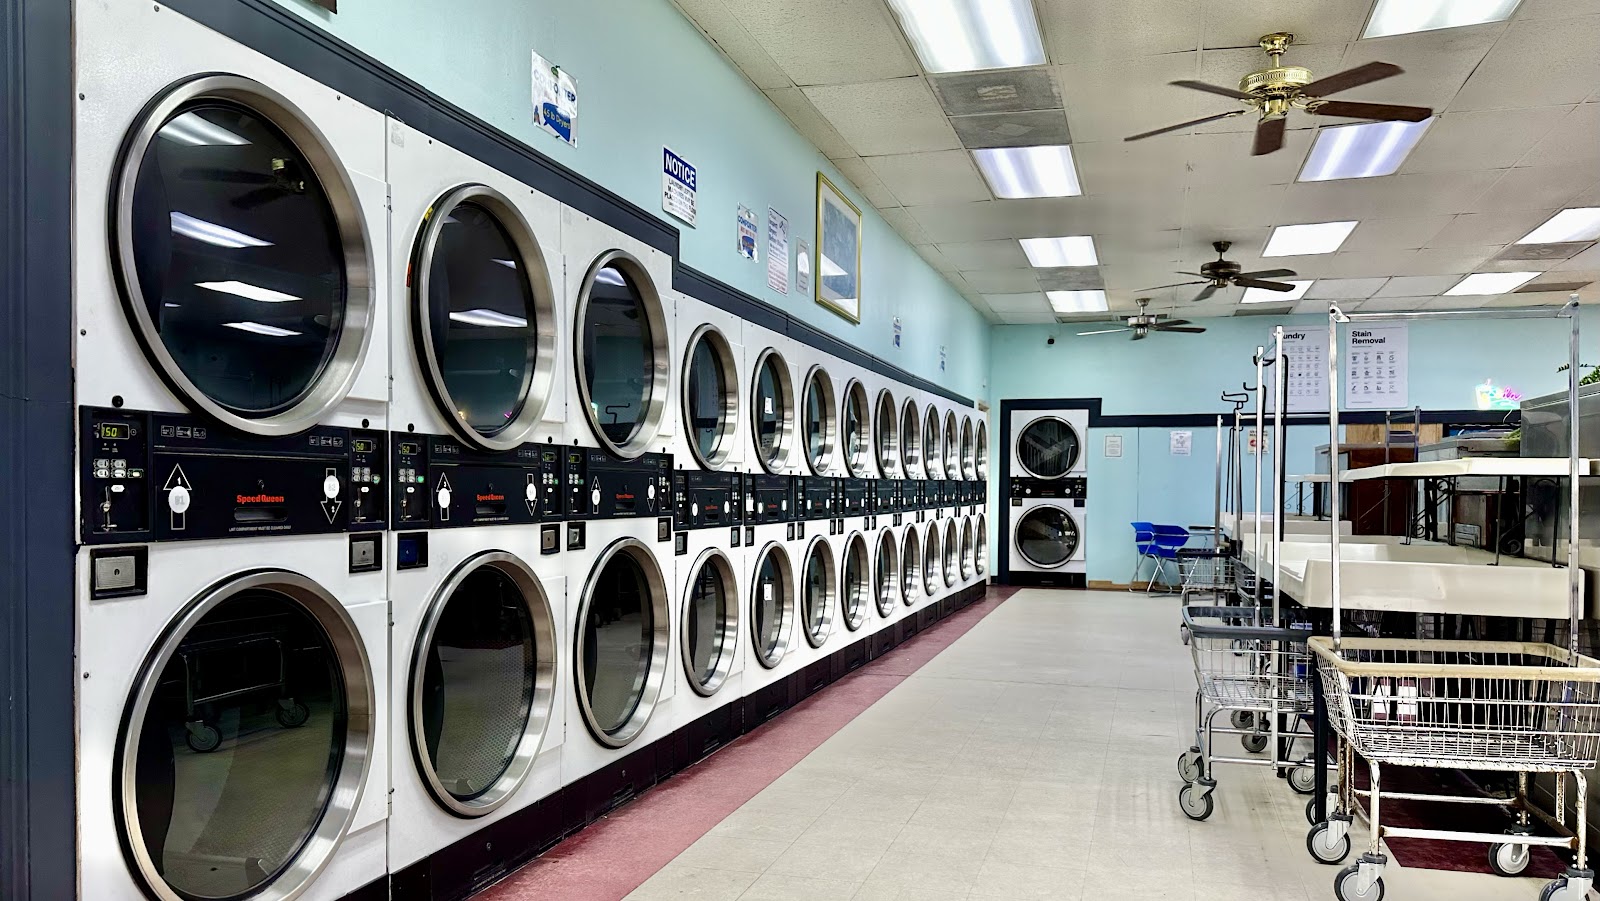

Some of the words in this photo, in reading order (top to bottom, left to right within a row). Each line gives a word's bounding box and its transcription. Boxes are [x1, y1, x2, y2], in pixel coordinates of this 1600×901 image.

[665, 153, 695, 188] NOTICE
[236, 494, 261, 504] Speed
[261, 494, 285, 503] Queen
